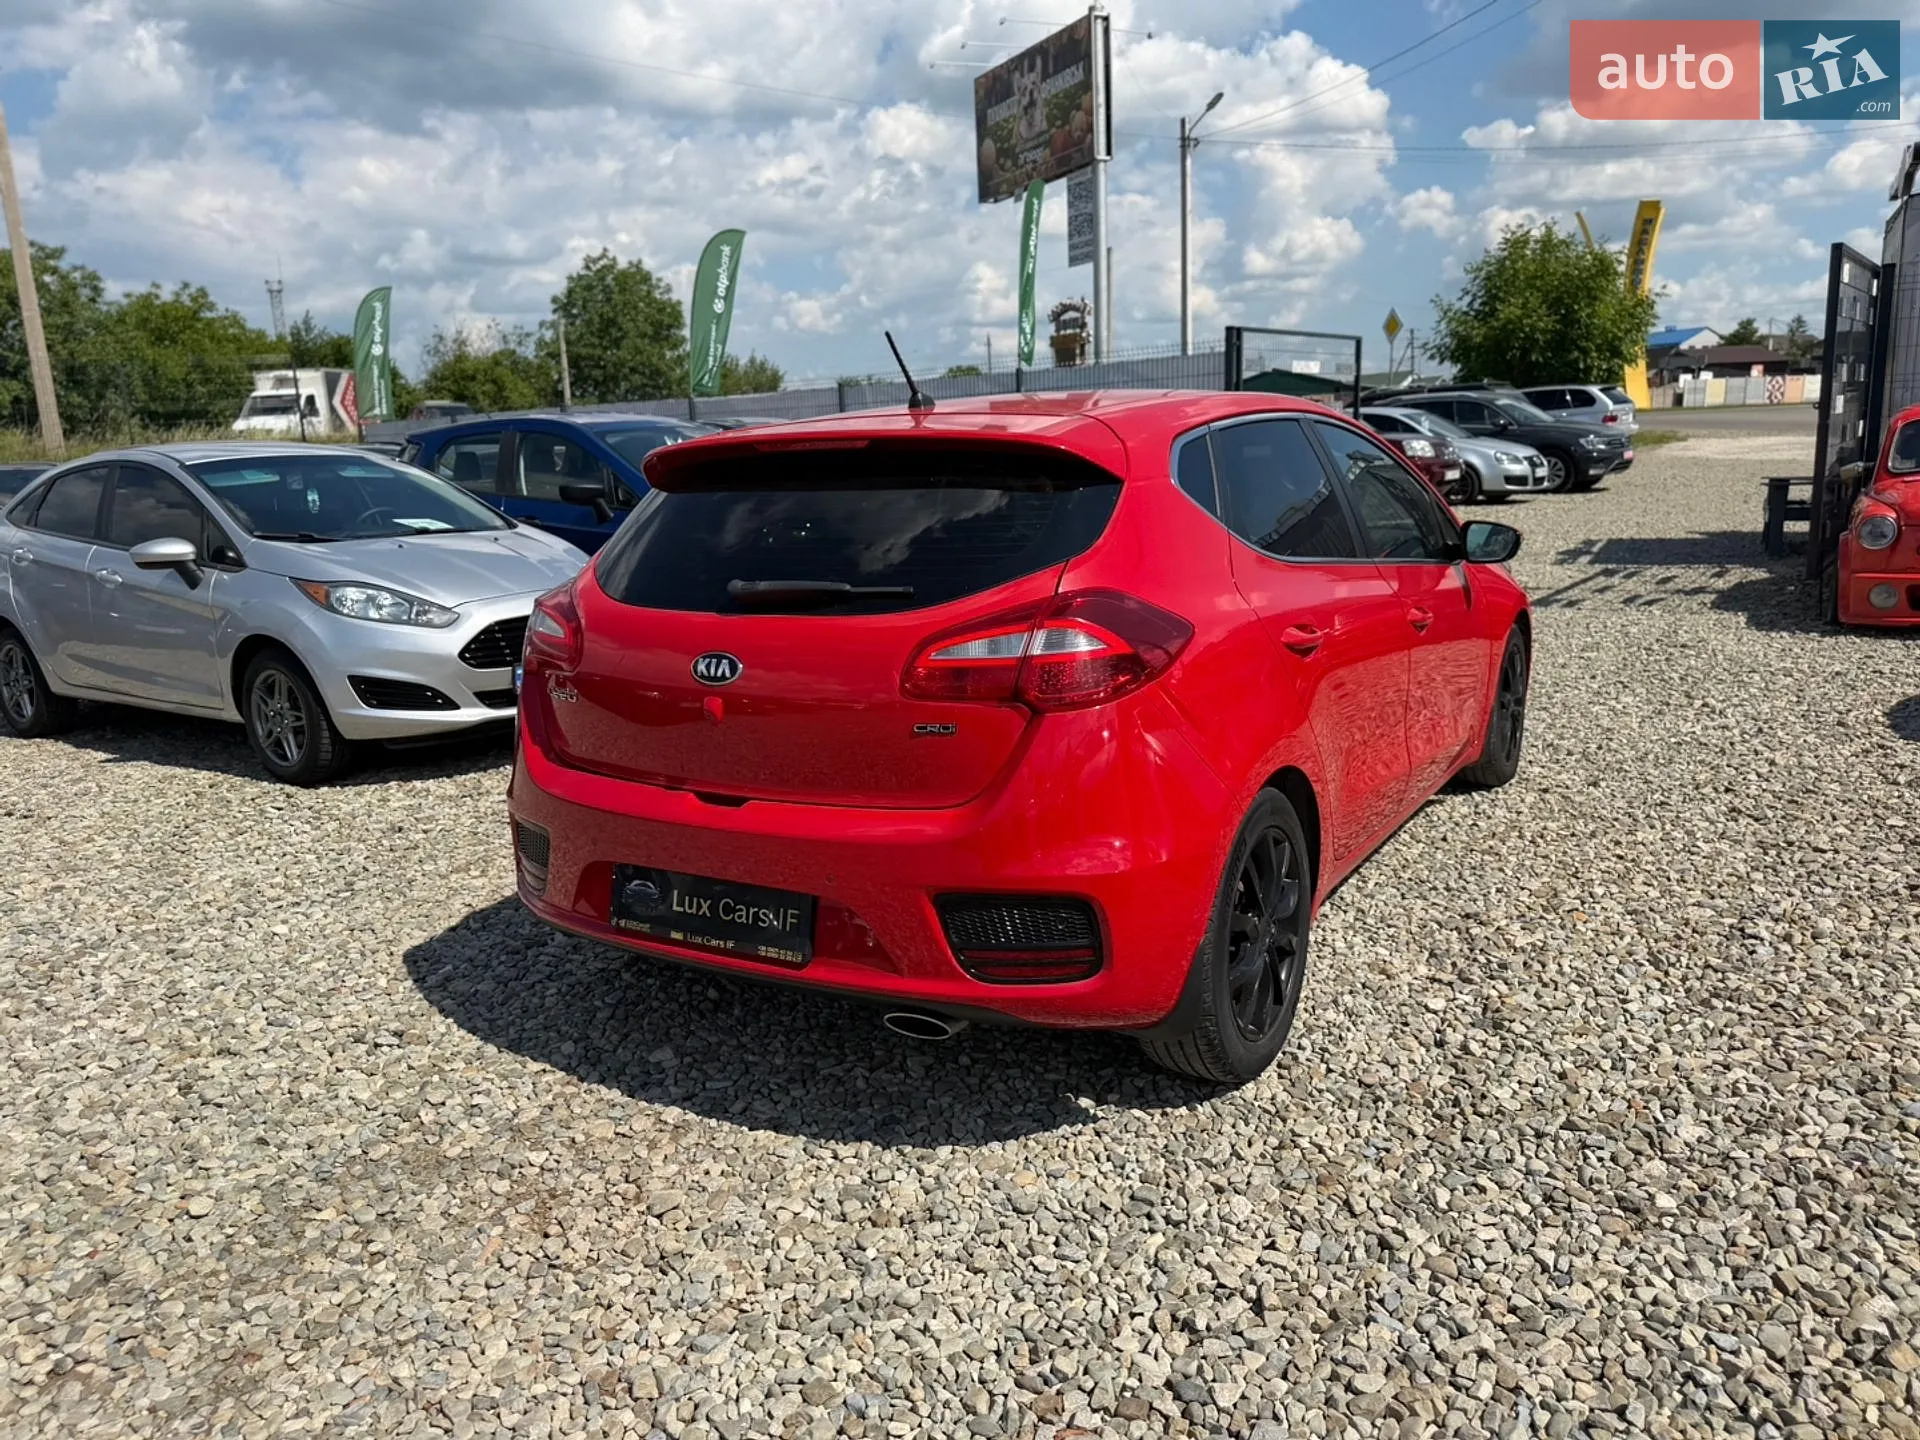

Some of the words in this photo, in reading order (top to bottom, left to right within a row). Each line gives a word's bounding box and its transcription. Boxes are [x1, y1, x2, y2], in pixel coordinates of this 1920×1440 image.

[696, 657, 732, 679] KIA
[913, 721, 956, 733] CRDi
[671, 888, 712, 918] Lux
[718, 898, 770, 928] Cars
[777, 906, 801, 932] IF
[687, 931, 704, 944] Lux
[704, 934, 726, 949] Cars
[726, 939, 736, 950] IF
